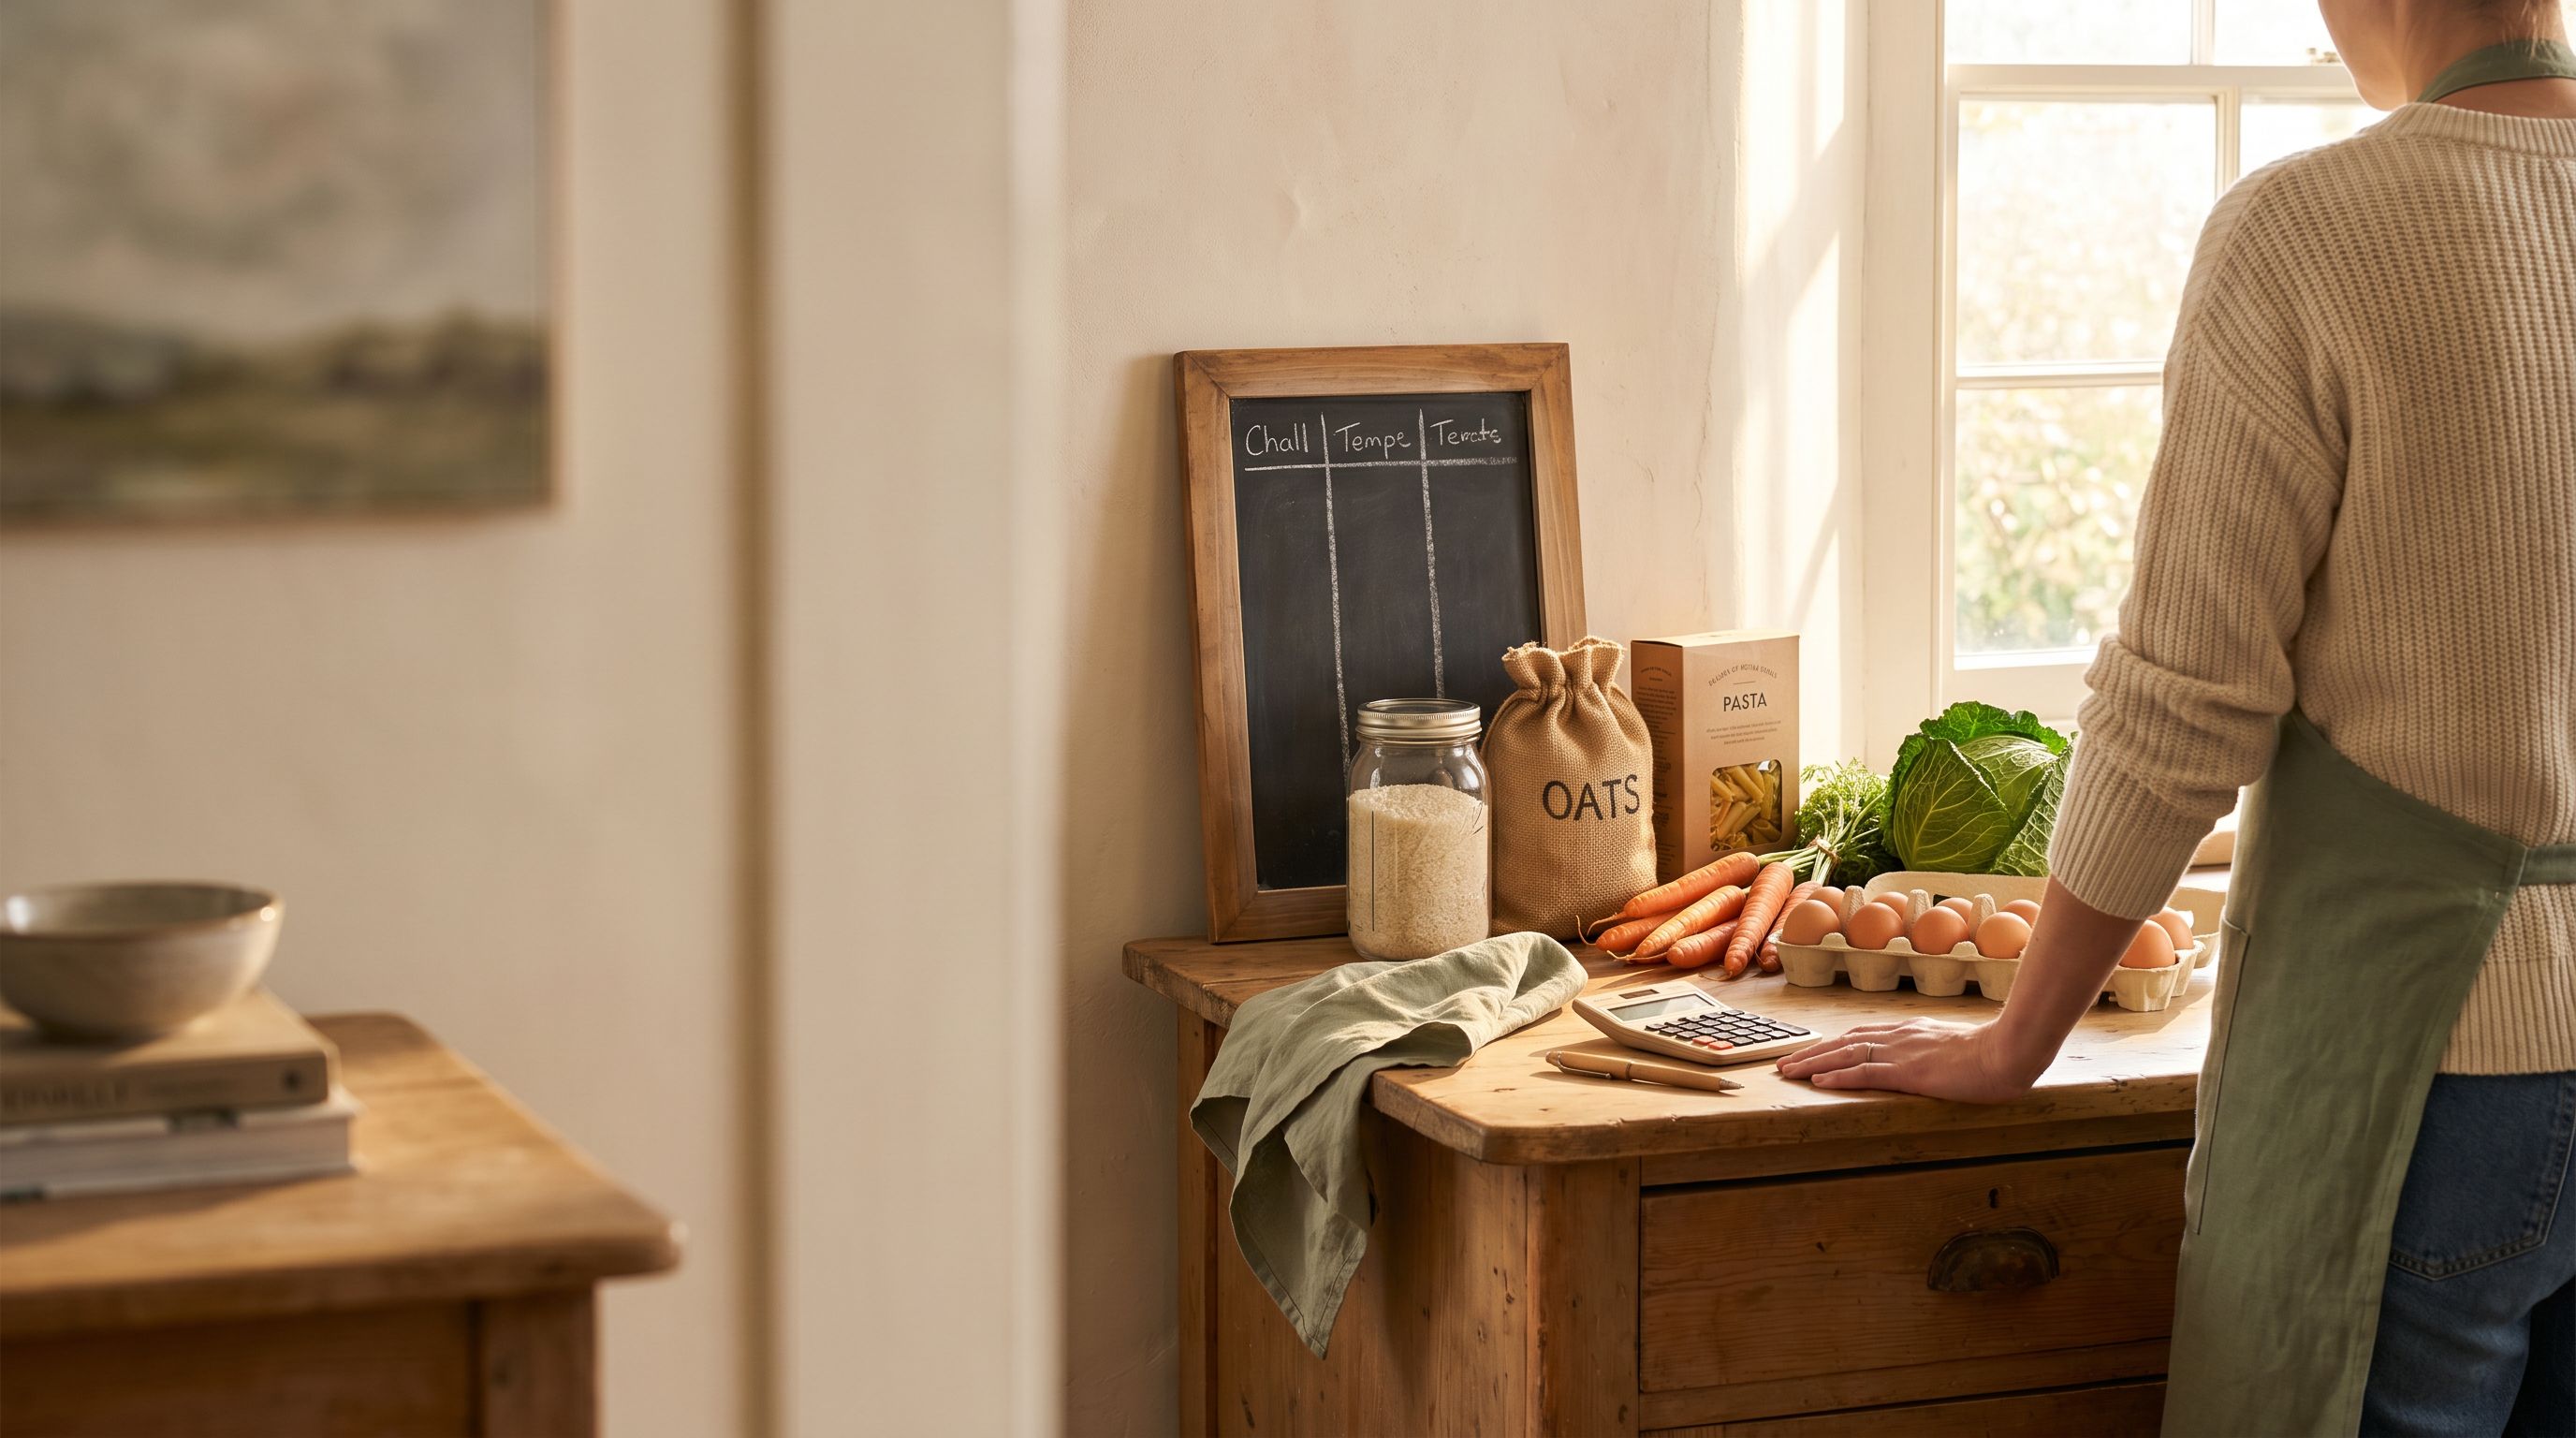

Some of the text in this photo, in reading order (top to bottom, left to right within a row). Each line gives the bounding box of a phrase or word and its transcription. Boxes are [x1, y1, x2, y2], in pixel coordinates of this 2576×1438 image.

[1245, 422, 1309, 456] Chall
[1334, 422, 1412, 460] Tempe
[1723, 692, 1767, 712] PASTA
[1542, 773, 1641, 821] OATS
